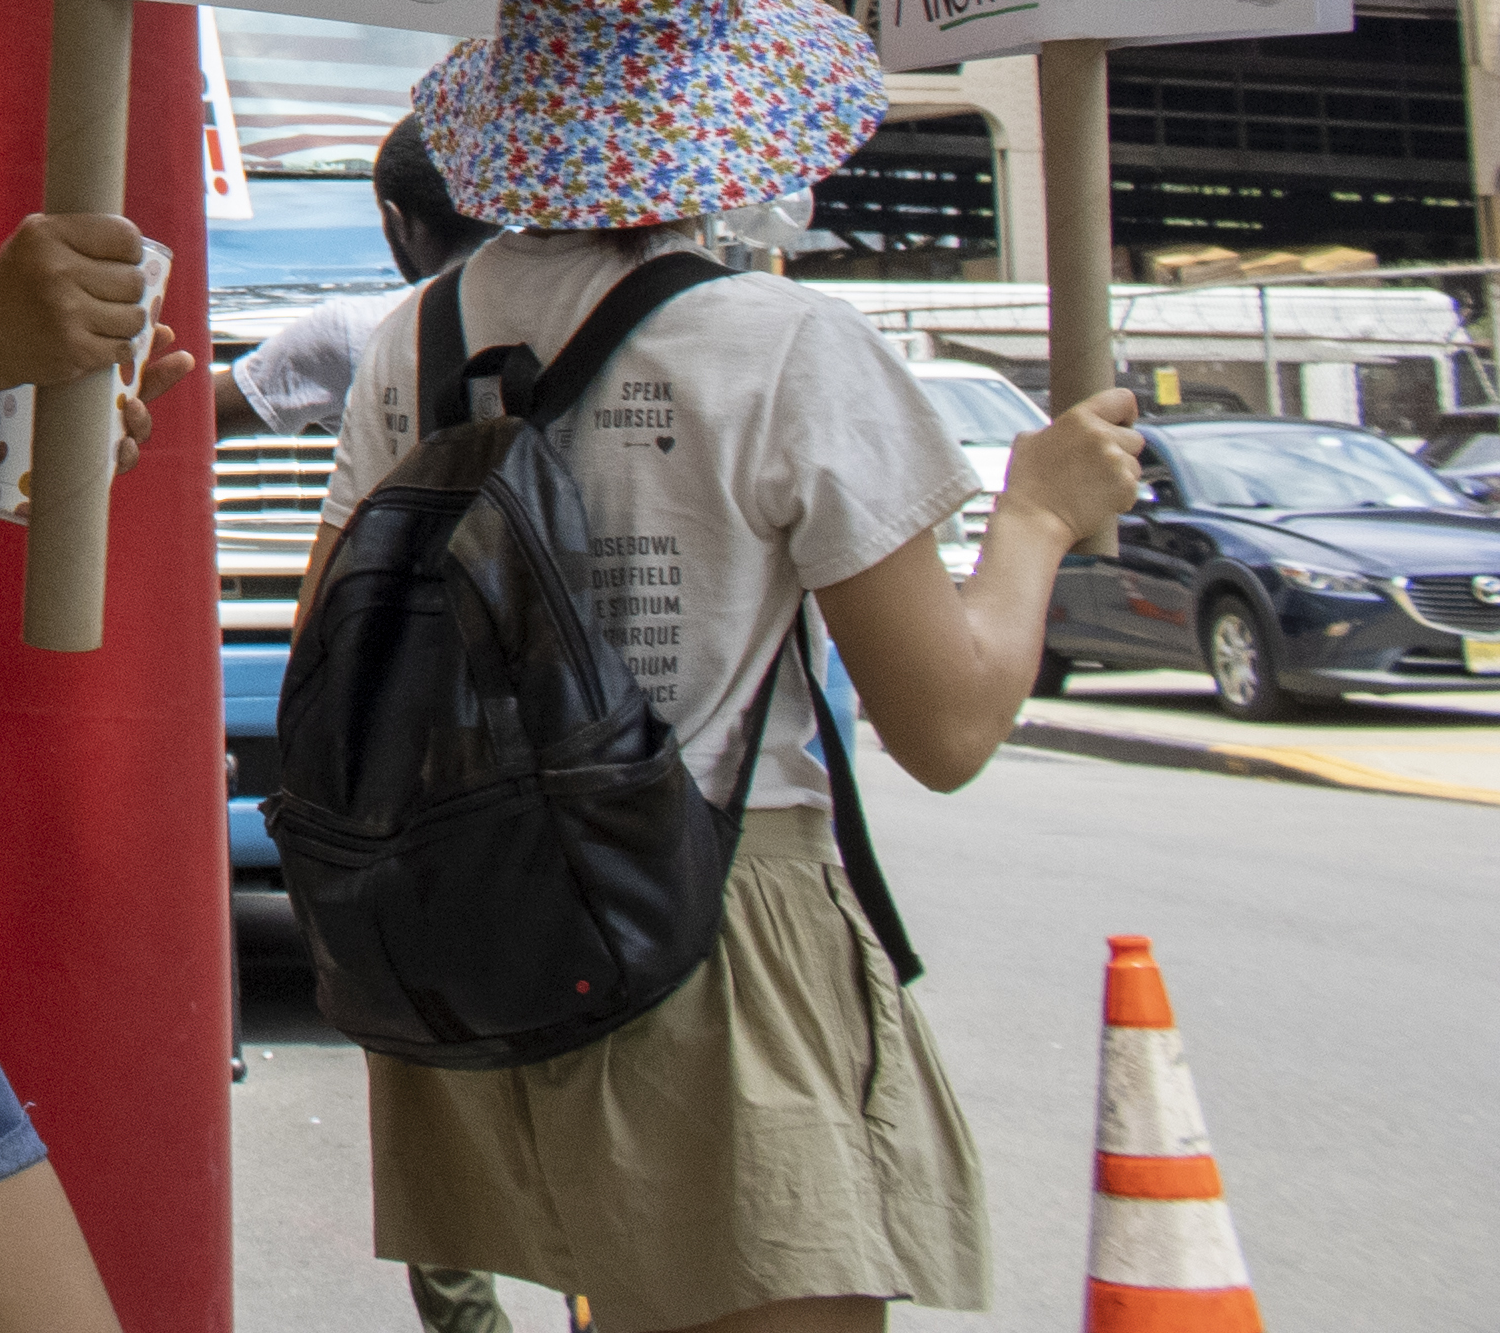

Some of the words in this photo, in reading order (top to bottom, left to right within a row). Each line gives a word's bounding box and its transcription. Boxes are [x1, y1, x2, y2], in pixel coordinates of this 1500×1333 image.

[621, 381, 672, 401] SPEAK
[594, 408, 674, 429] YOURSELF
[591, 536, 681, 558] OSEBOWL
[630, 566, 682, 586] FIELD
[628, 656, 678, 676] DIUM
